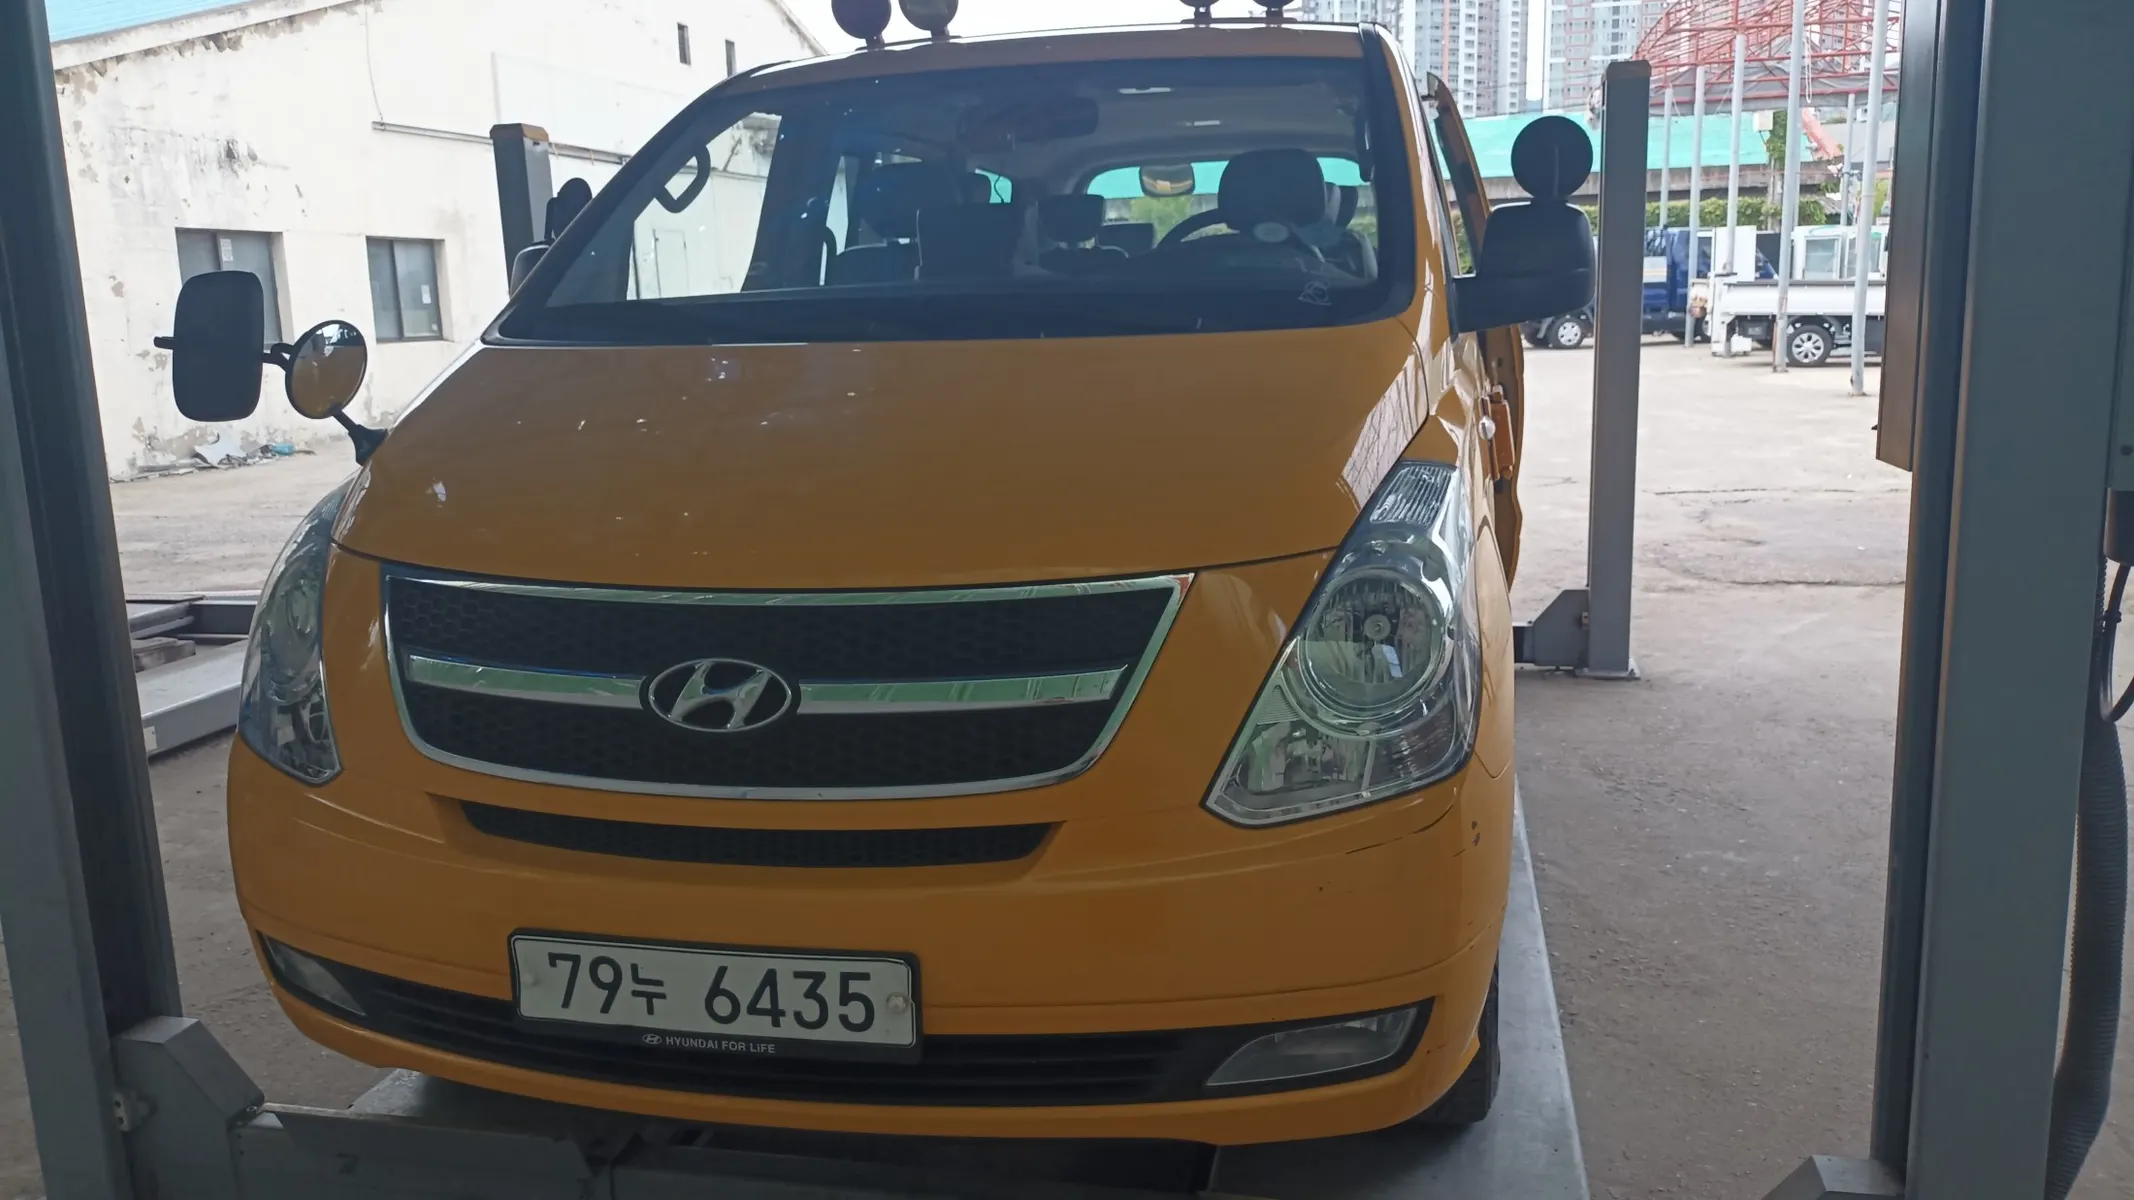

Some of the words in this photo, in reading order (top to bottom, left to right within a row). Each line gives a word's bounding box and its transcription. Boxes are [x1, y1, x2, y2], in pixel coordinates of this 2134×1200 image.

[547, 952, 667, 1016] 79누
[704, 965, 875, 1032] 6435
[665, 1036, 718, 1049] HYUNDAI
[721, 1041, 746, 1051] FOR
